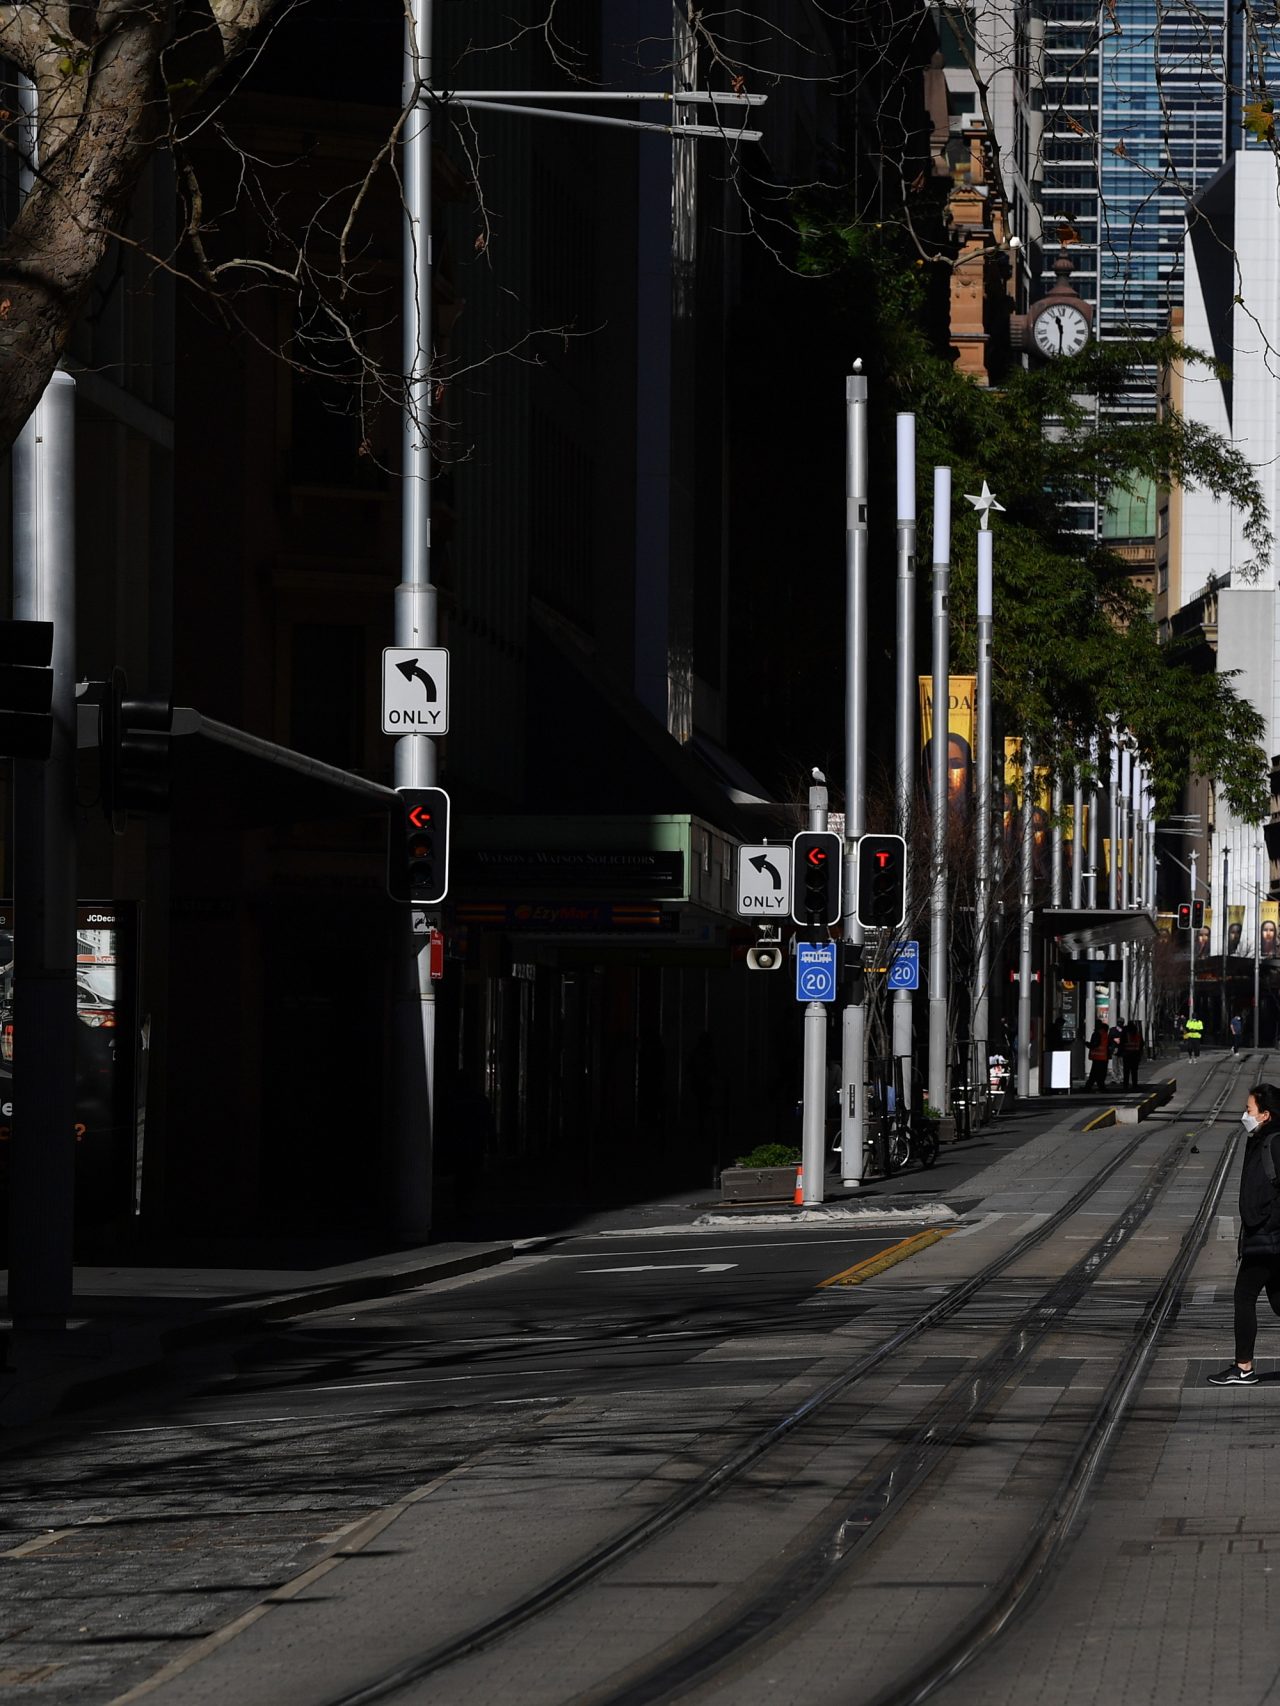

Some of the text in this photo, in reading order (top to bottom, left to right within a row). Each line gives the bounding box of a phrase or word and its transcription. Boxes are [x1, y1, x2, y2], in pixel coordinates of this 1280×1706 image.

[924, 695, 972, 709] ADA
[388, 709, 441, 725] ONLY
[585, 850, 656, 865] SOLICITORS
[742, 896, 785, 908] ONLY
[894, 967, 911, 980] 20
[806, 974, 827, 990] 20
